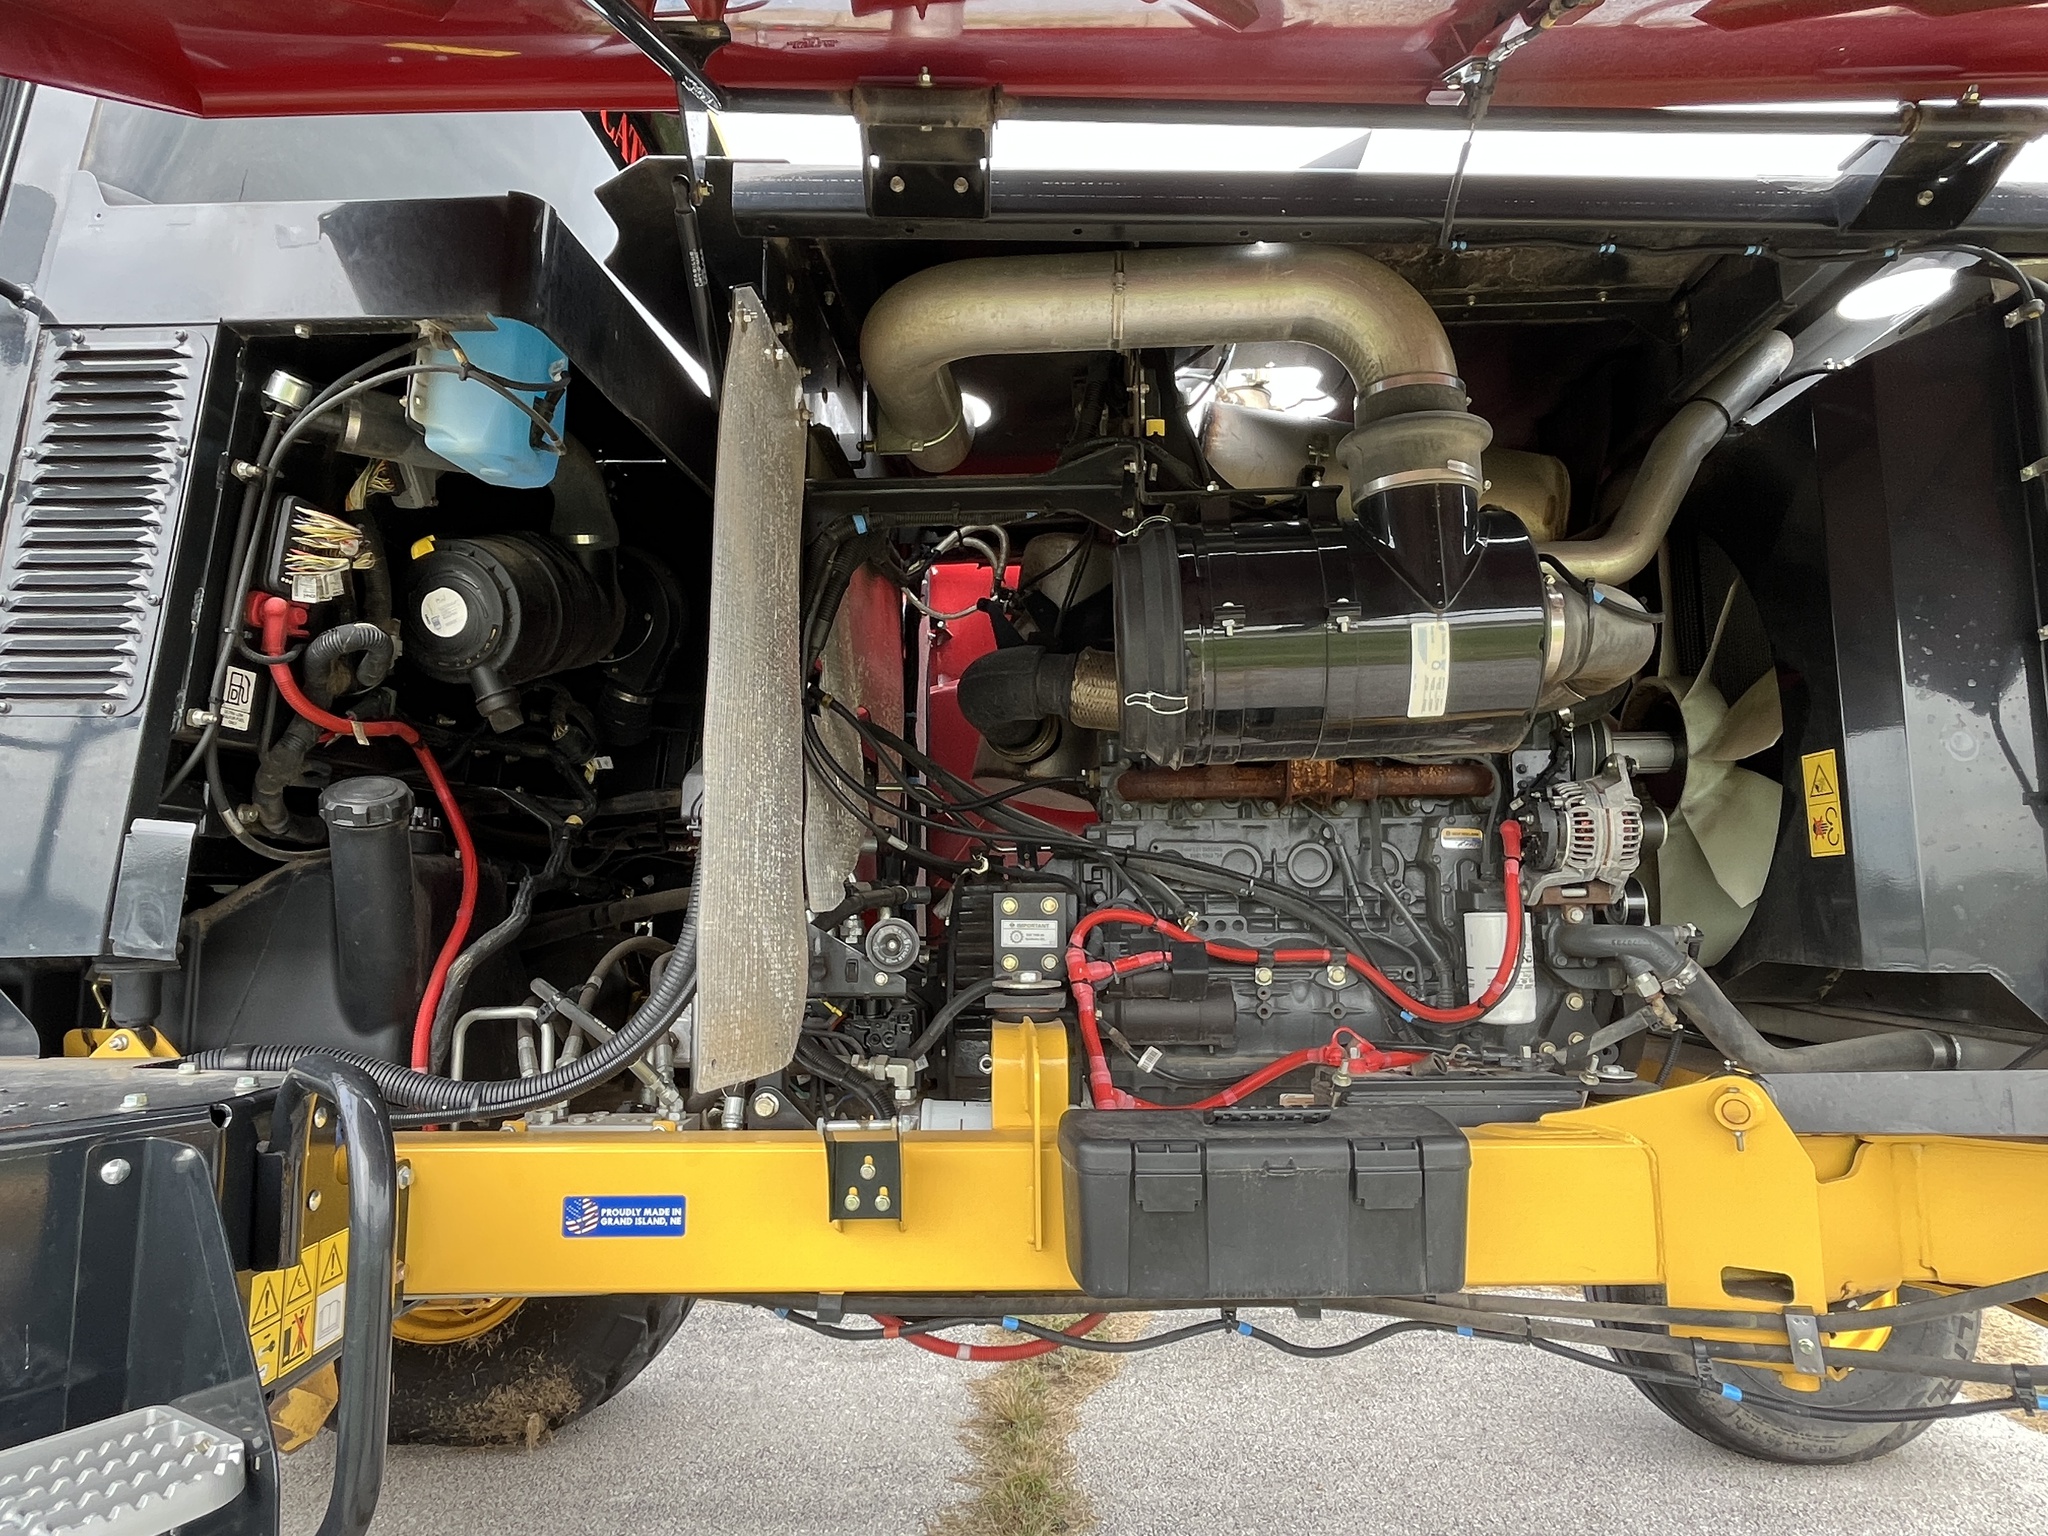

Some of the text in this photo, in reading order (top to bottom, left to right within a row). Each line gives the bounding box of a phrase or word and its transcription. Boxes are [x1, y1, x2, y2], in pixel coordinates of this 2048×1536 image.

[601, 1207, 682, 1217] PROUDLY MADE IN
[600, 1217, 682, 1227] GRAND ISLAND, NE
